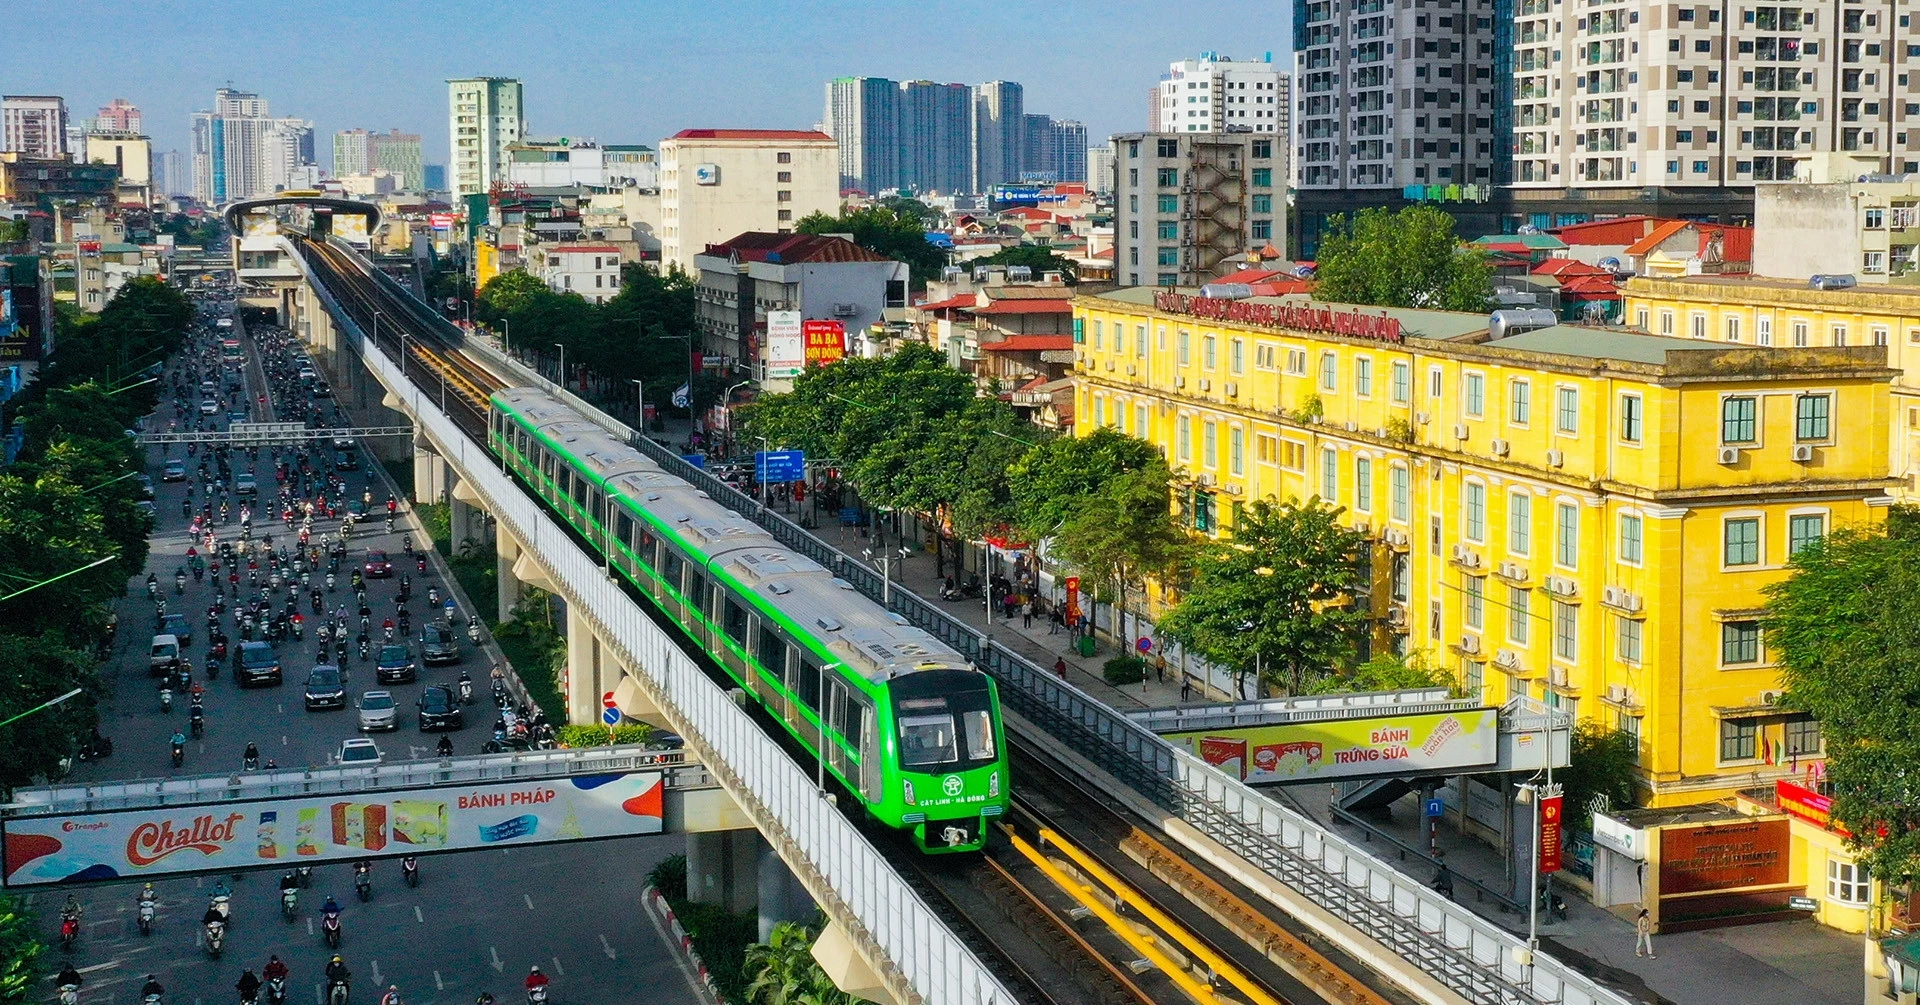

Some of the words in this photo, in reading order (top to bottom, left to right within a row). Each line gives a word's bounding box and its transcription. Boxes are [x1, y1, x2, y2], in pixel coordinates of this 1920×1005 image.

[810, 333, 823, 344] BA
[825, 333, 838, 344] BA
[1371, 728, 1409, 744] BÁNH
[1334, 747, 1379, 763] TRỨNG
[1382, 745, 1409, 760] SỮA
[458, 792, 506, 809] BÁNH
[510, 787, 556, 806] PHÁP
[935, 797, 951, 805] LINH
[127, 813, 243, 867] Challot
